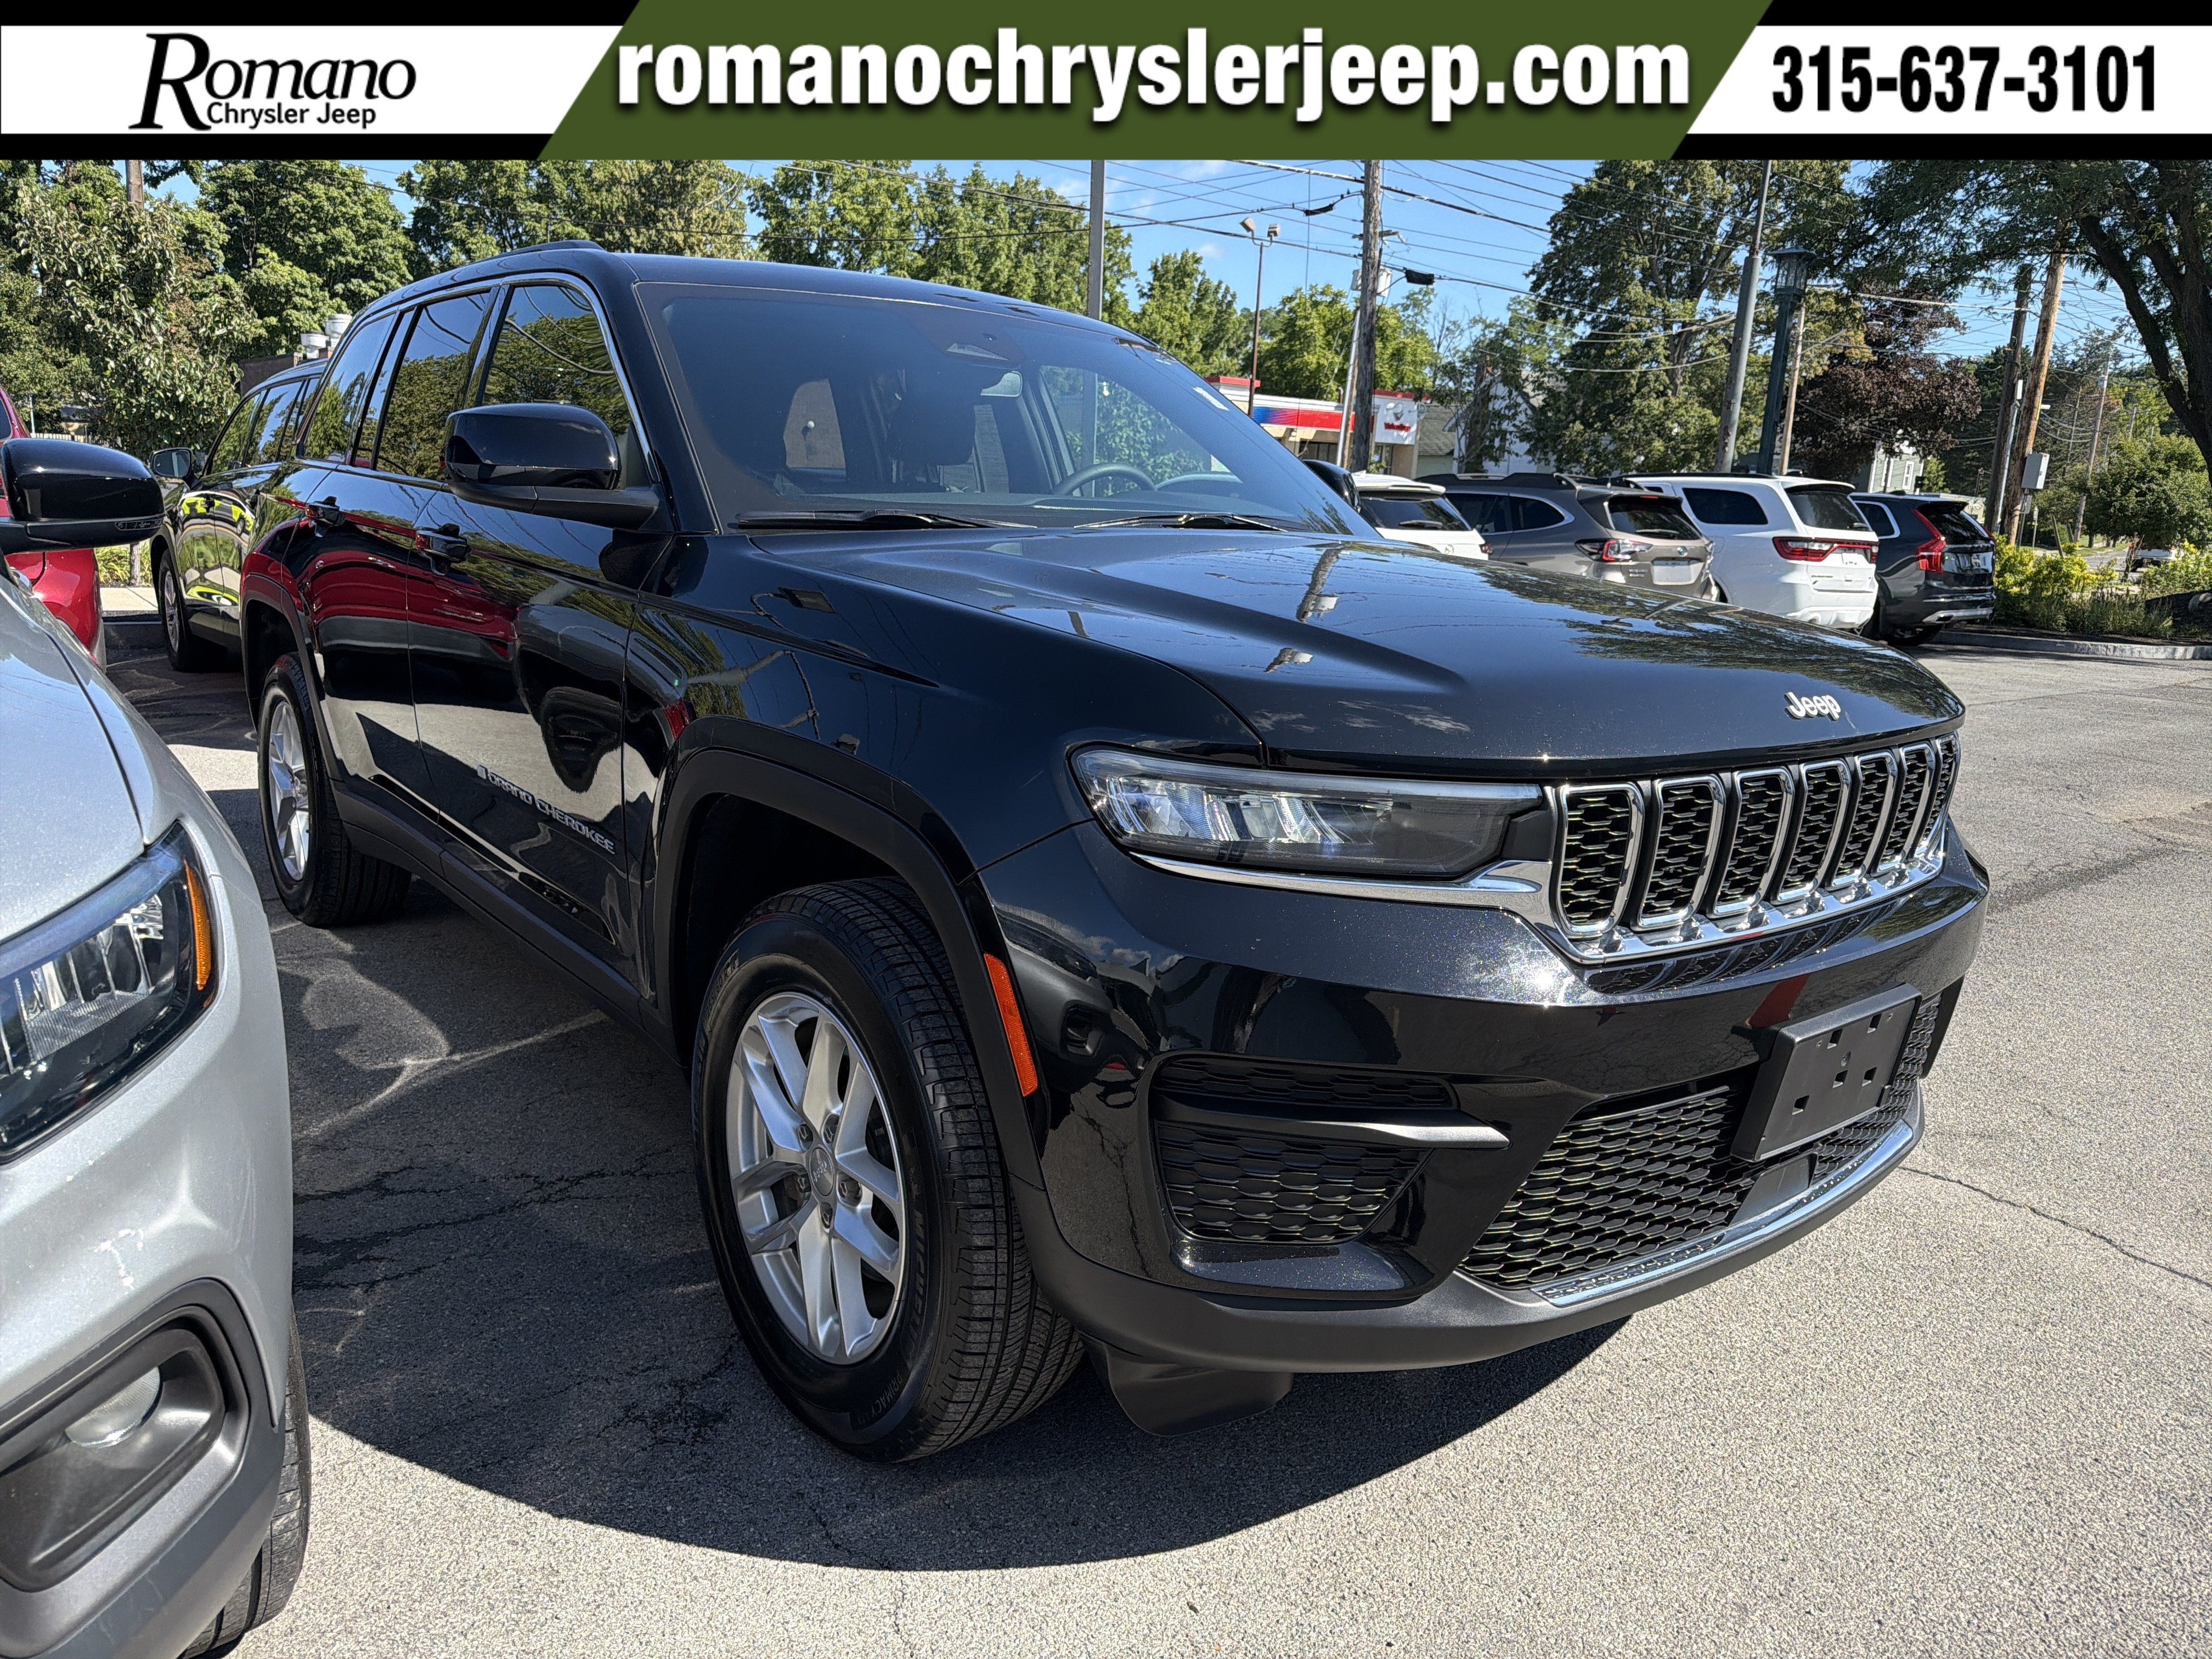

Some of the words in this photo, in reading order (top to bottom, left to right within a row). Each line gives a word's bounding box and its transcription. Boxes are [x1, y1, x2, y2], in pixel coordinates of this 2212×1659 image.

[1784, 692, 1842, 721] Jeep
[487, 771, 534, 805] GRAND
[535, 798, 616, 855] CHEROKEE
[907, 1208, 926, 1355] MICHELIN
[870, 1368, 904, 1418] PRIMACY
